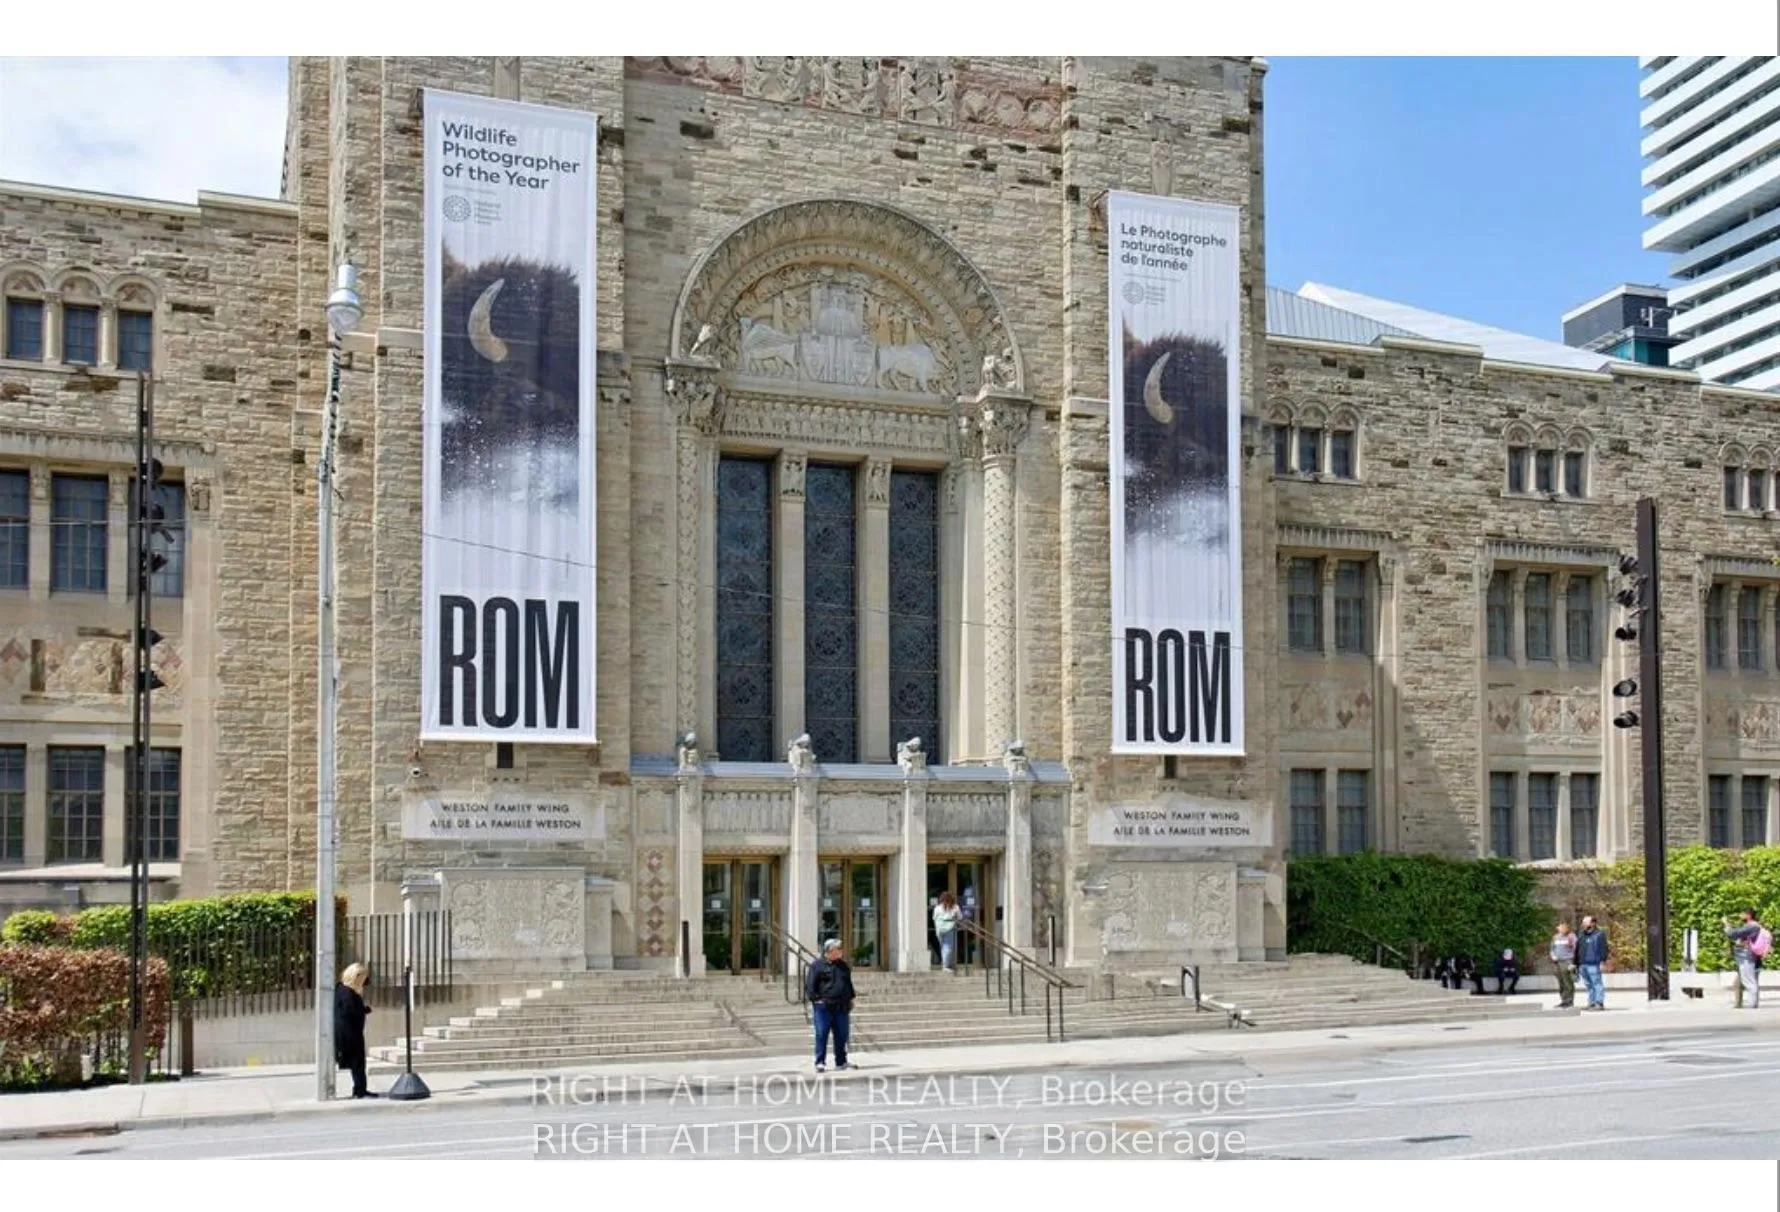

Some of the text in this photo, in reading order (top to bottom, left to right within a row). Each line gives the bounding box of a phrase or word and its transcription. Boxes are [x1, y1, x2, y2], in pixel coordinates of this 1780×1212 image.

[442, 120, 518, 147] Wildlife
[443, 141, 580, 173] Photographer
[442, 163, 549, 190] of the Year
[1120, 222, 1227, 247] Le Photographe
[1121, 239, 1194, 257] naturaliste
[1121, 252, 1138, 265] de
[439, 594, 579, 729] ROM
[1125, 627, 1231, 743] ROM
[441, 803, 570, 813] WESTON FAMILY WING
[1124, 811, 1240, 821] WESTON FAMILY WING
[430, 819, 582, 829] AILE DE LA FAMILLE WESTON
[1114, 827, 1250, 836] AILE DE LA FAMILLE WESTON
